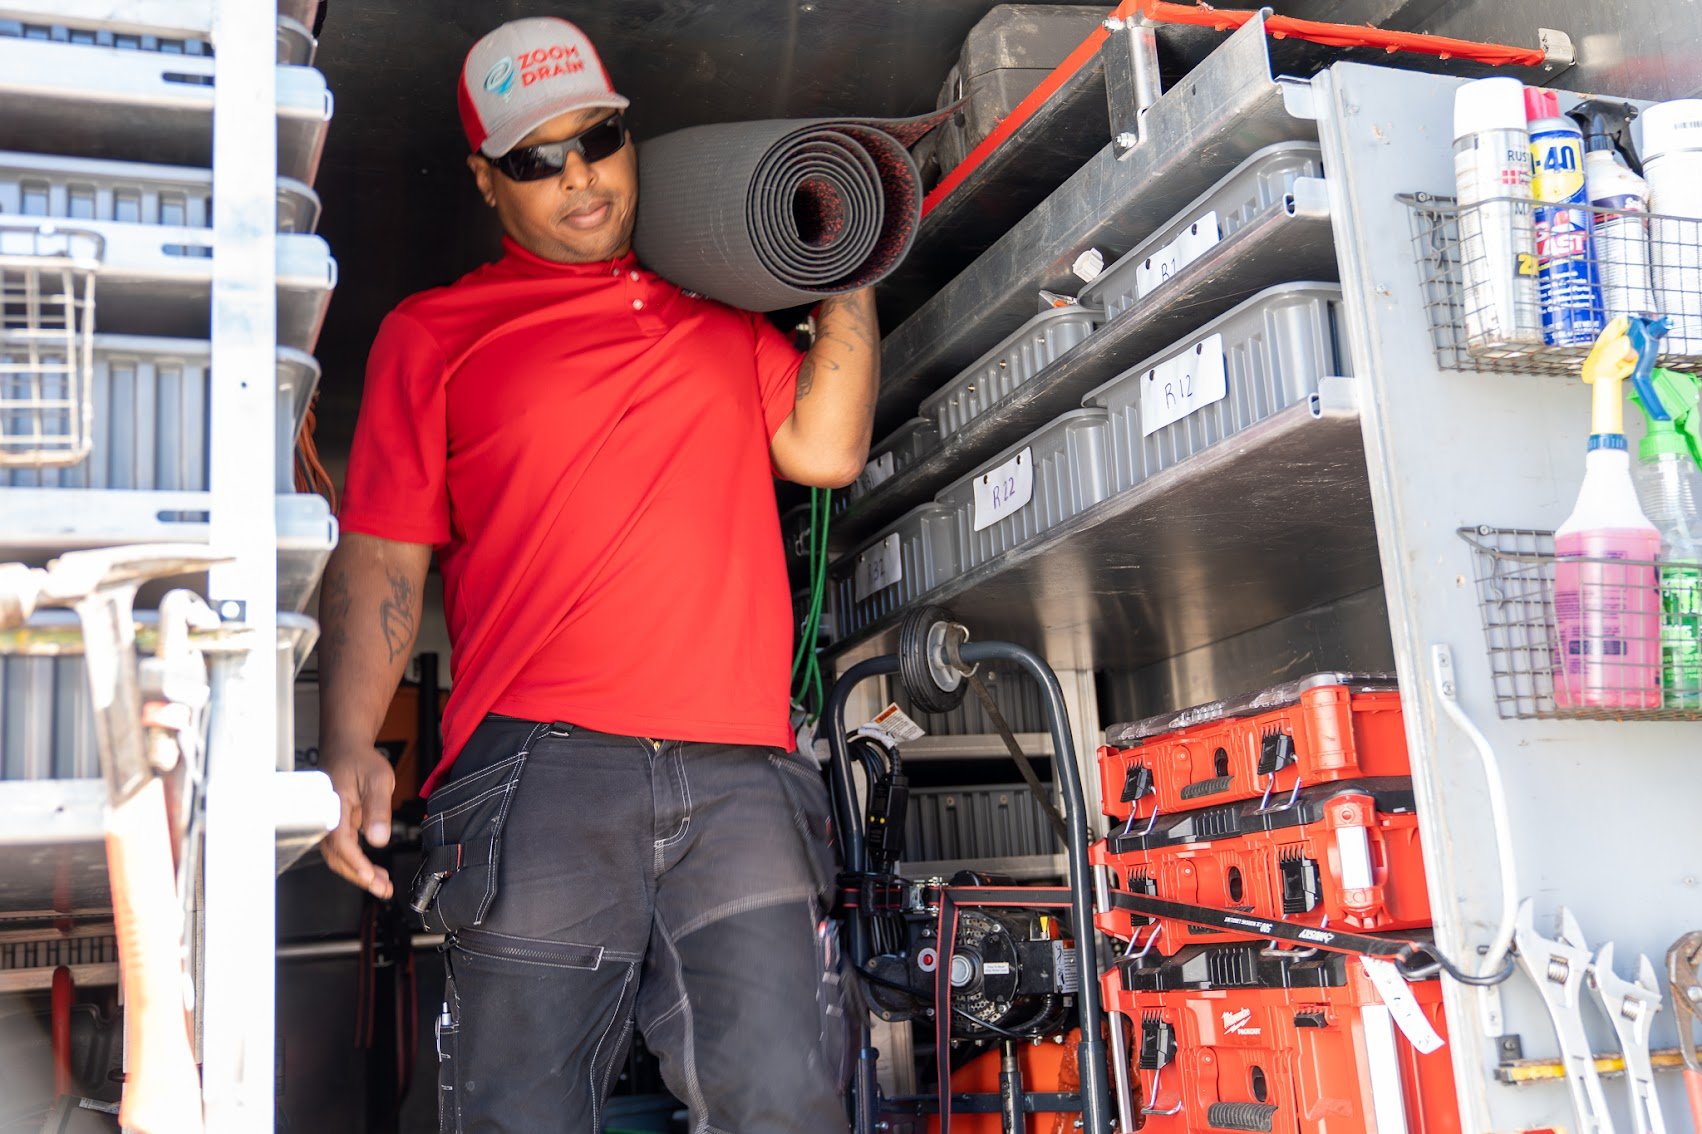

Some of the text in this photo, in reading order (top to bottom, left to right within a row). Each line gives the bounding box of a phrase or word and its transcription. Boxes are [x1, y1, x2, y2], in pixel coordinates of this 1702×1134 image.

[517, 45, 580, 69] ZOOM
[522, 60, 584, 87] DRAIN
[1507, 151, 1528, 162] RUS
[1530, 145, 1577, 175] -40
[1164, 374, 1193, 409] R12
[992, 476, 1016, 510] R22
